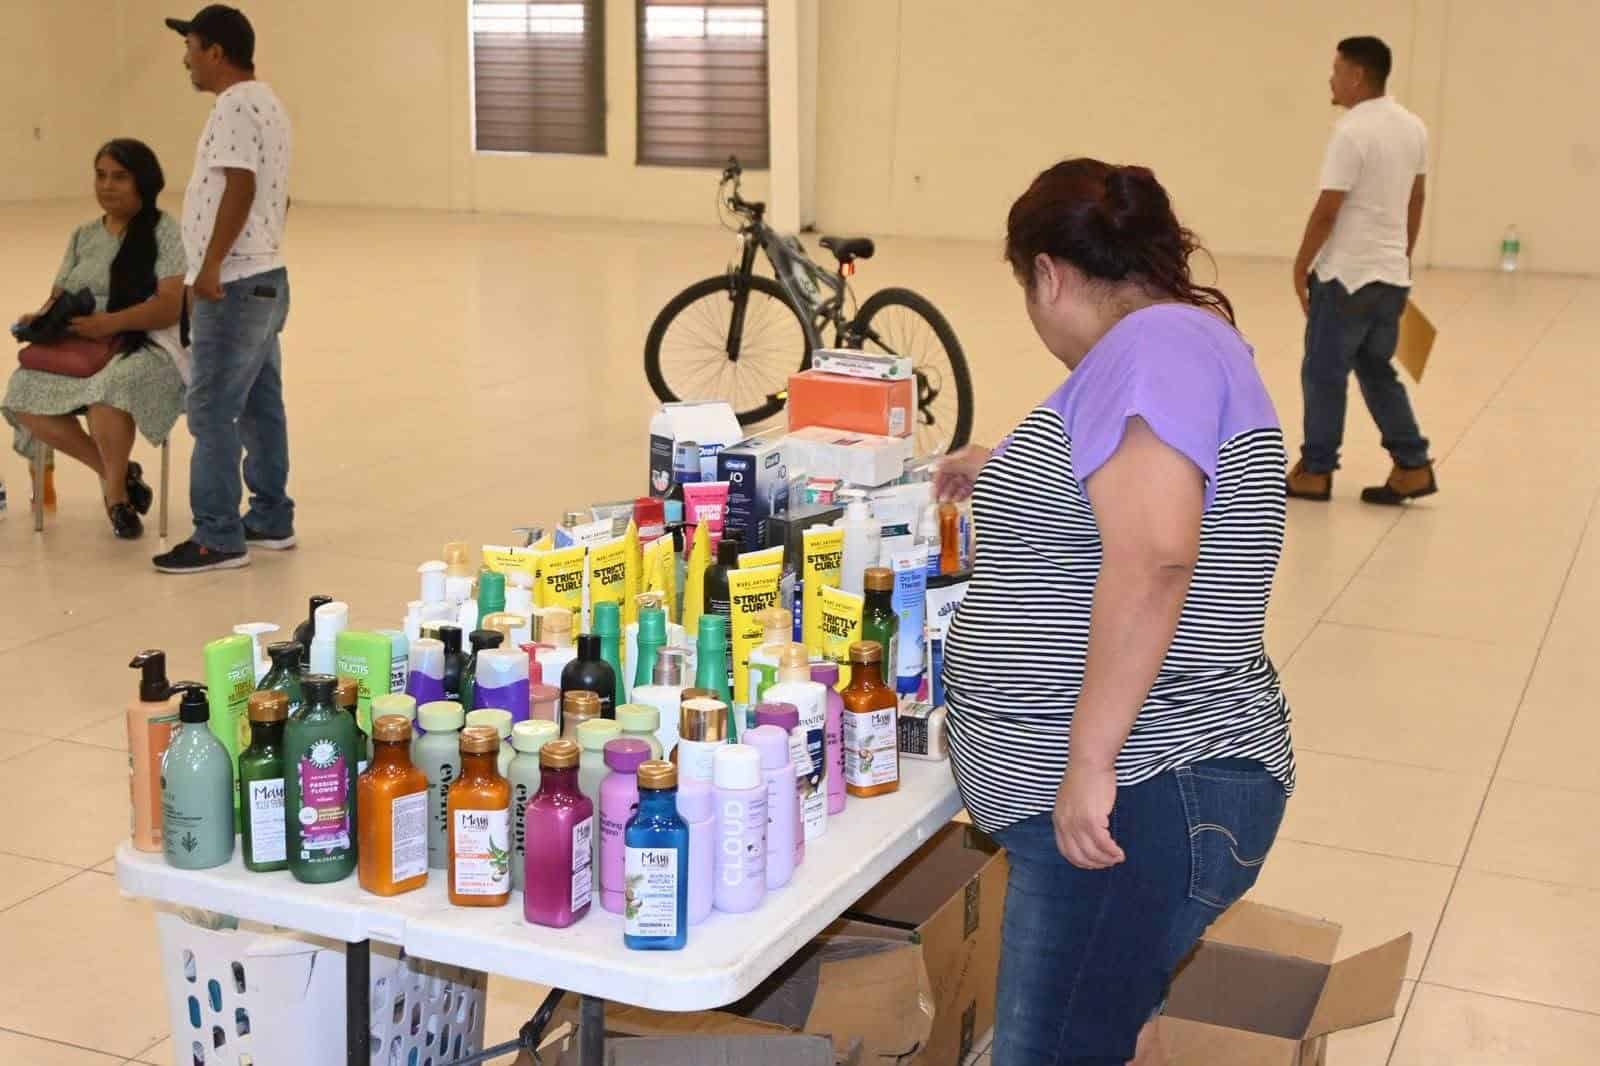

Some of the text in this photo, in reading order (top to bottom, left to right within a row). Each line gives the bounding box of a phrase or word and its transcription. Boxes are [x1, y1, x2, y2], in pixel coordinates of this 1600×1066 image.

[593, 563, 625, 578] STRICTL
[814, 560, 841, 572] CURLS
[546, 570, 583, 585] STRICTL
[254, 786, 285, 801] Mau
[723, 800, 744, 887] CLOUD
